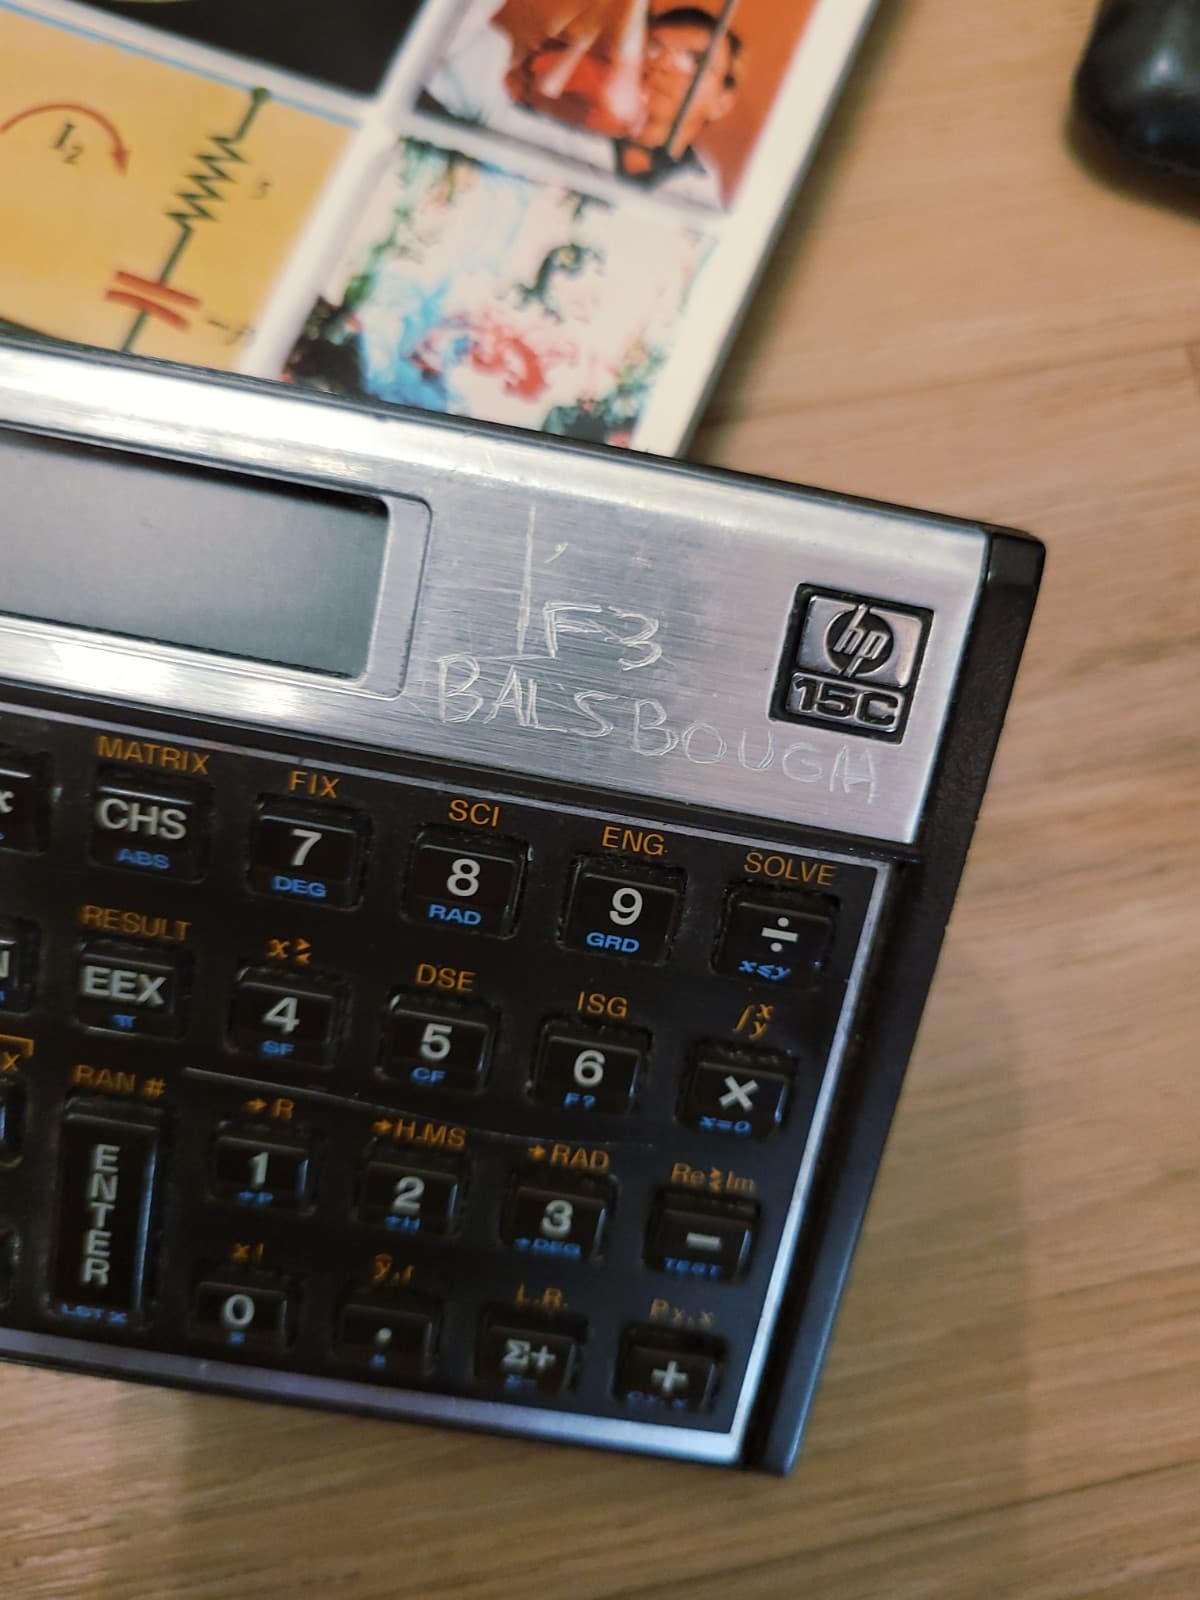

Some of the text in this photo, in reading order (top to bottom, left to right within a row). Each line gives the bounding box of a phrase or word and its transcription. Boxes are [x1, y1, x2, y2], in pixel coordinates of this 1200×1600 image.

[832, 602, 890, 678] hp
[793, 675, 899, 732] 15C
[96, 735, 210, 775] MATRIX
[288, 770, 340, 799] FIX
[98, 798, 188, 841] CHS
[448, 799, 499, 827] SCI
[115, 848, 170, 870] ABS
[289, 829, 322, 866] 7
[602, 826, 666, 857] ENG
[272, 875, 327, 898] DEG
[446, 858, 482, 897] 8
[743, 851, 837, 887] SOLVE
[80, 904, 192, 942] RESULT
[428, 904, 482, 926] RAD
[608, 887, 643, 926] 9
[586, 932, 640, 954] GRD
[82, 965, 167, 1005] EEX
[415, 963, 476, 993] DSE
[262, 997, 300, 1034] 4
[576, 991, 629, 1019] ISG
[260, 1039, 295, 1057] SF
[420, 1023, 452, 1061] 5
[71, 1063, 136, 1092] RAN
[411, 1066, 446, 1083] CF
[573, 1049, 606, 1088] 6
[273, 1097, 295, 1120] R
[248, 1151, 269, 1186] 1
[549, 1143, 610, 1171] RAD
[393, 1175, 425, 1214] 2
[82, 1143, 121, 1286] ENTER
[540, 1199, 574, 1238] 3
[223, 1293, 255, 1327] 0
